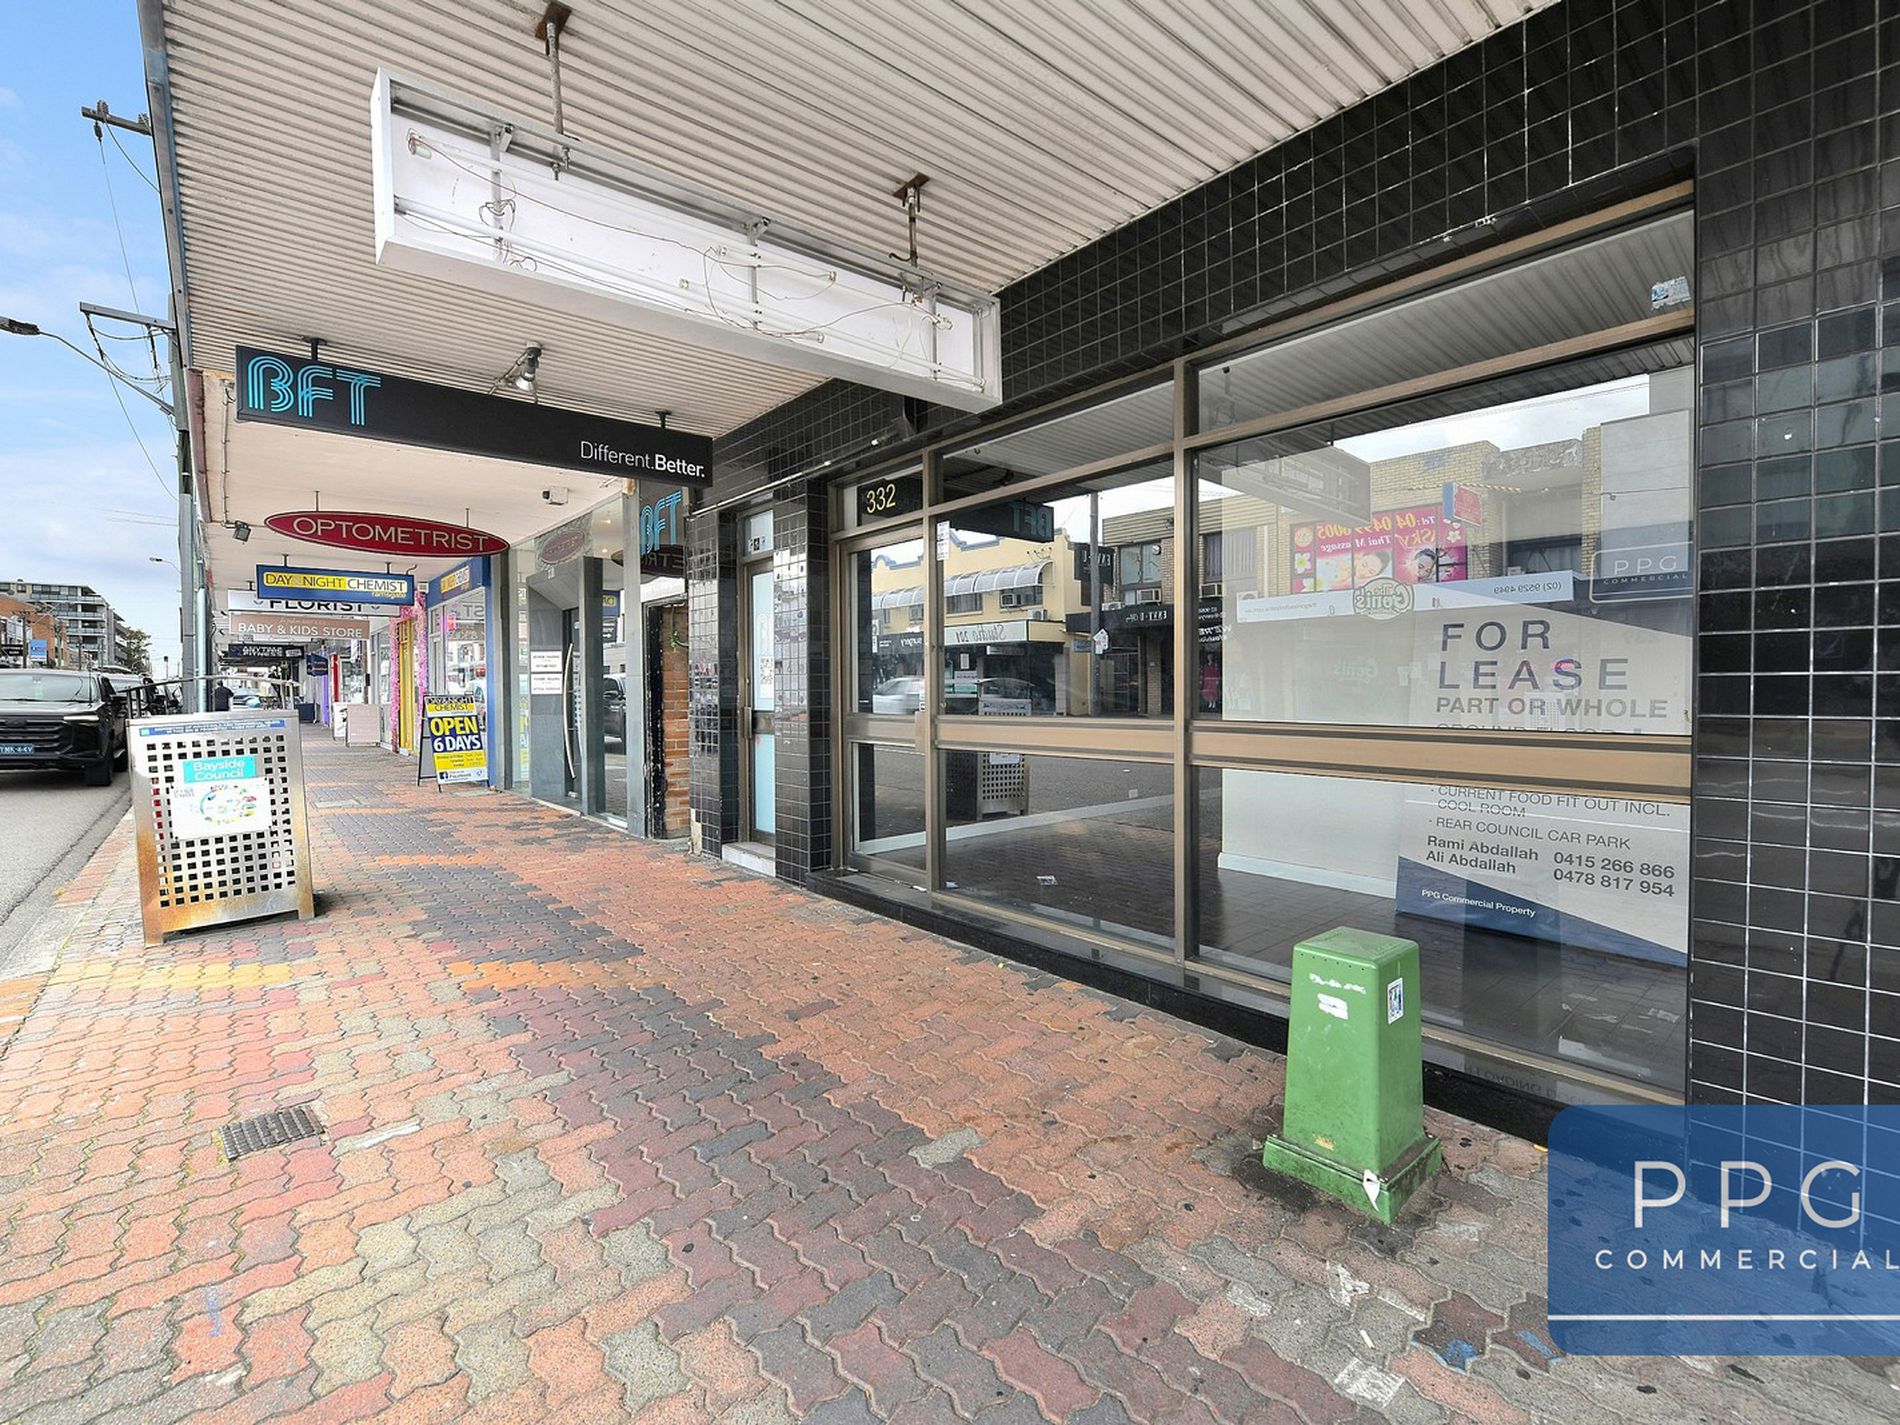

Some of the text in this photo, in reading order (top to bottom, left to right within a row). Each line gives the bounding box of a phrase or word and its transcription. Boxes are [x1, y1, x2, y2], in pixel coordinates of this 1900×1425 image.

[247, 356, 382, 426] BFT
[866, 483, 896, 513] 332
[293, 517, 489, 552] OPTOMETRIST
[640, 490, 682, 557] BFT
[1603, 573, 1688, 585] COMMERCIAL
[1614, 556, 1677, 576] PPG
[347, 578, 406, 592] CHEMIST
[238, 622, 273, 634] BABY
[277, 624, 287, 635] &
[289, 624, 319, 637] KIDS
[323, 629, 363, 639] STORE
[1441, 619, 1550, 651] FOR
[1438, 658, 1629, 691] LEASE
[1436, 696, 1668, 718] PART OR WHOLE
[430, 716, 478, 736] OPEN
[433, 735, 481, 752] 6 DAYS
[193, 759, 245, 772] Bayside
[194, 768, 244, 780] Council
[1437, 798, 1526, 817] COOL ROOM
[1438, 786, 1671, 817] CURRENT FOOD FIT OUT INCL.
[1436, 816, 1631, 850] REAR COUNCIL CAR PARK
[1427, 835, 1675, 879] Rami Abdallah 0415 266 866
[1426, 851, 1675, 897] Ali Abdallah 0478 817 954
[1421, 889, 1536, 918] PPG Commercial Property
